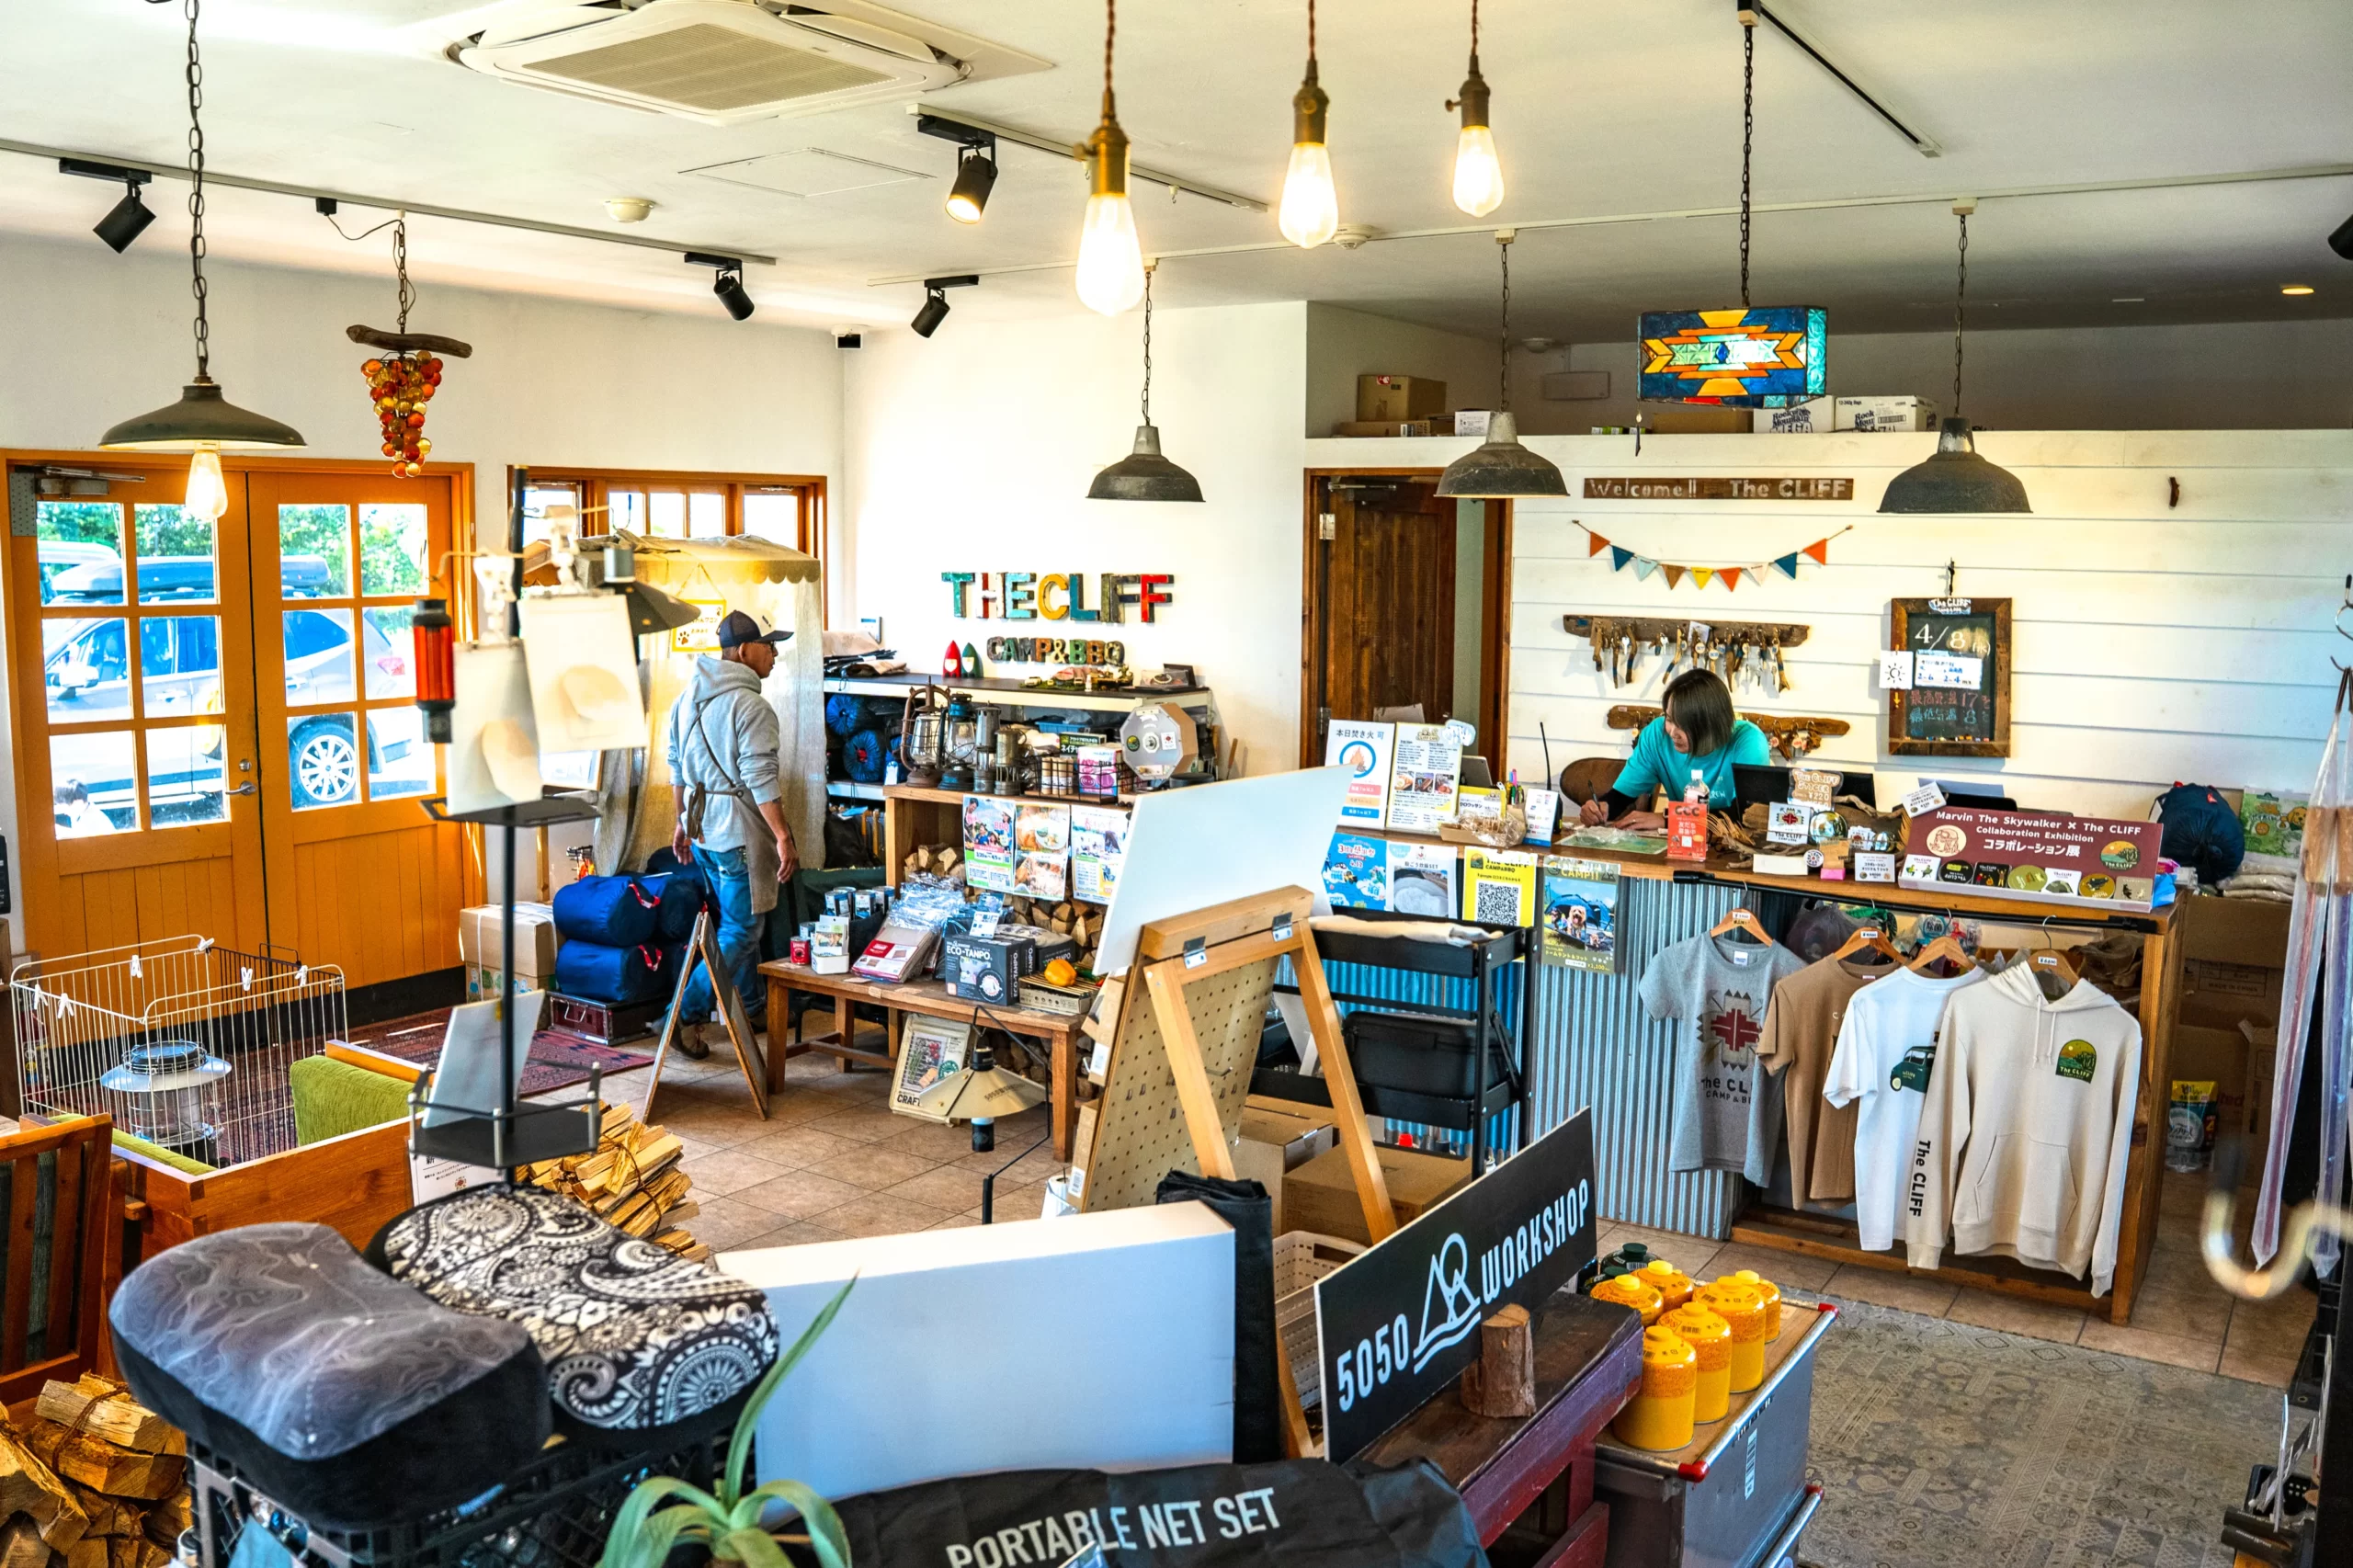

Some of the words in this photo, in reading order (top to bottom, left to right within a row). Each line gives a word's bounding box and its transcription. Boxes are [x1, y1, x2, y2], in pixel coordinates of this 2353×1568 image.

[1772, 415, 1809, 427] Mountain
[1729, 479, 1769, 497] The
[1778, 479, 1847, 498] CLIFF
[1930, 598, 1946, 608] The
[1947, 597, 1969, 608] CLIFF
[1936, 811, 1973, 822] Marvin
[1978, 814, 1999, 824] The
[2003, 816, 2062, 829] Skywalker
[2083, 823, 2104, 833] The
[2109, 824, 2142, 835] CLIFF
[1976, 825, 2040, 838] Collaboration
[2044, 831, 2094, 843] Exhibition
[1983, 838, 2081, 858] コラボレーション展
[946, 945, 992, 960] ECO-TANPO
[2072, 1068, 2090, 1078] CLIFF
[1706, 1090, 1731, 1100] CAMP
[1915, 1140, 1931, 1166] The
[1909, 1172, 1927, 1217] CLIFF
[1337, 1313, 1409, 1413] 5050
[1481, 1178, 1589, 1305] WORKSHOP
[945, 1506, 1138, 1568] PORTABLE
[1138, 1501, 1207, 1549] NET
[1212, 1487, 1281, 1540] SET
